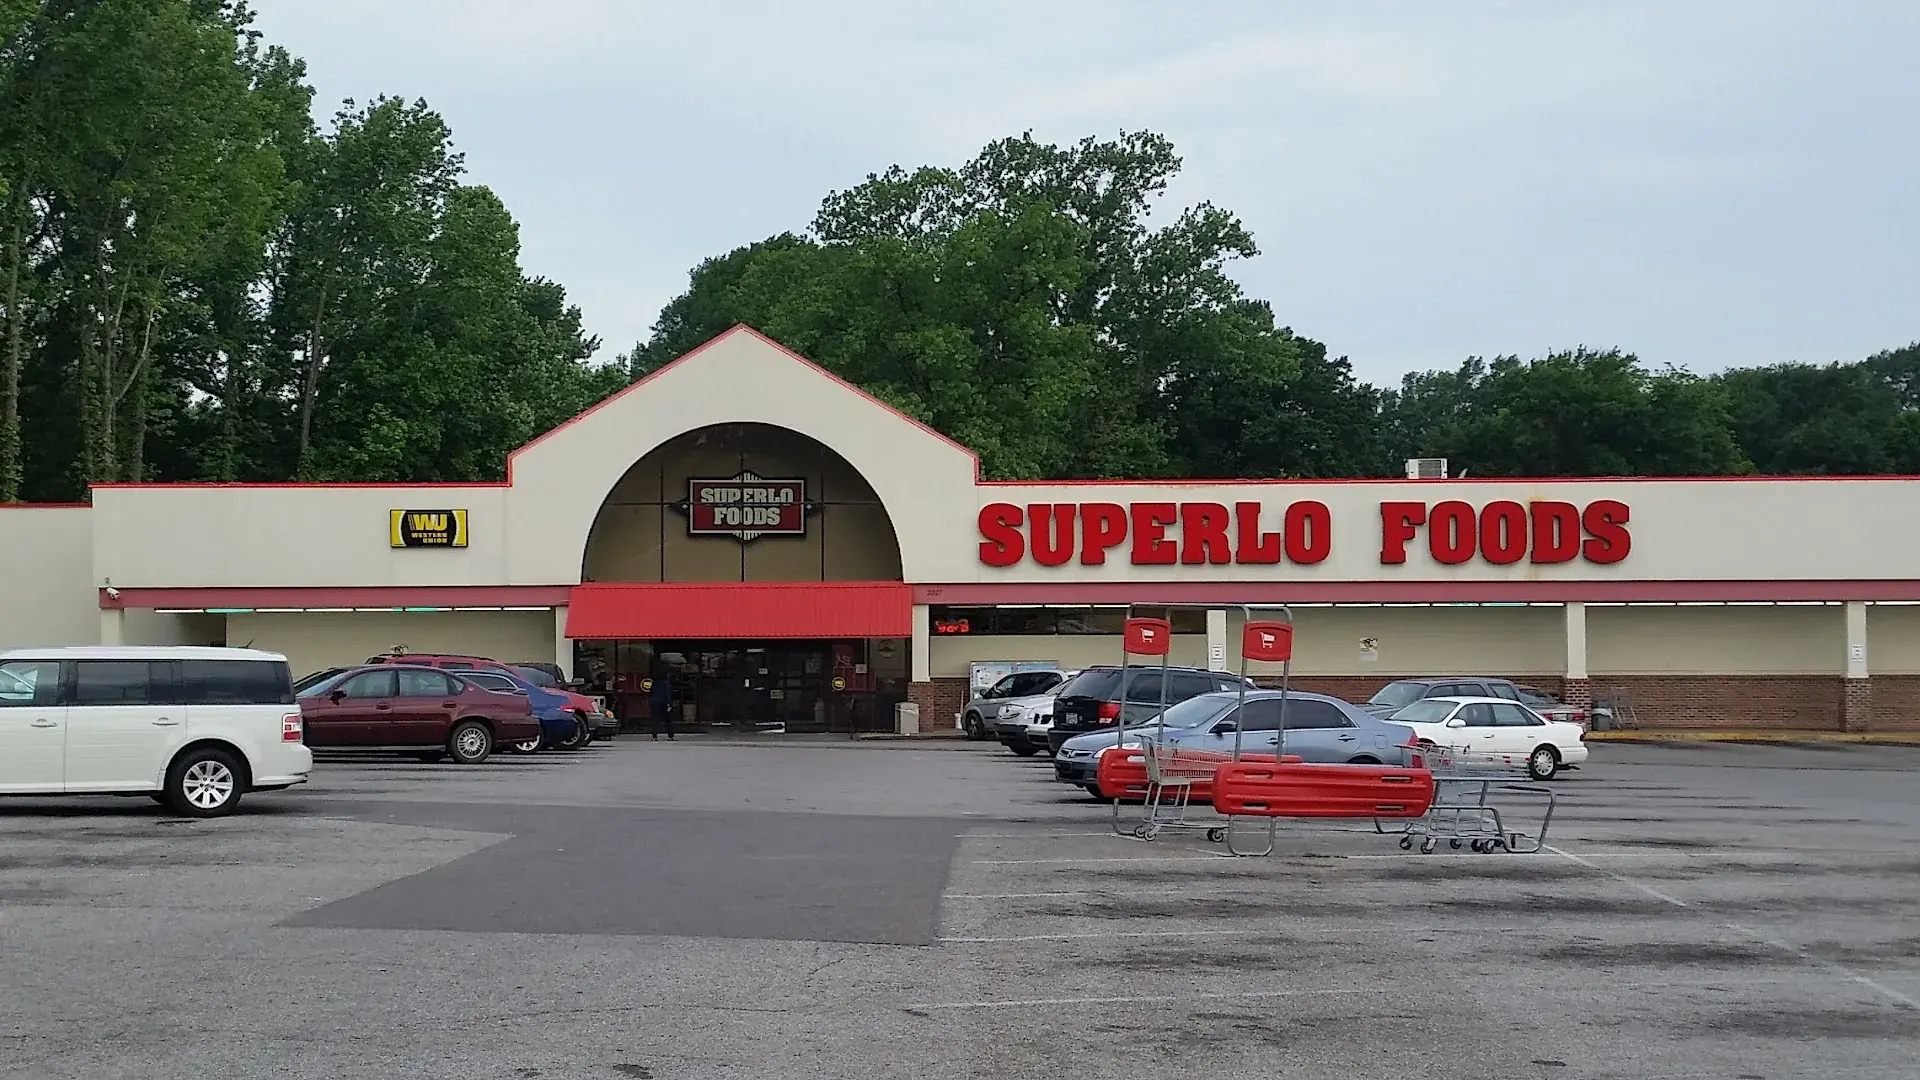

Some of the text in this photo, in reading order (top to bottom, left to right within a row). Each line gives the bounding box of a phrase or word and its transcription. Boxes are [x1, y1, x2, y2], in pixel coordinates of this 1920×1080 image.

[700, 487, 794, 506] SUPERLO
[408, 514, 448, 531] WU
[713, 506, 781, 525] FOODS
[978, 499, 1632, 567] SUPERLO FOODS
